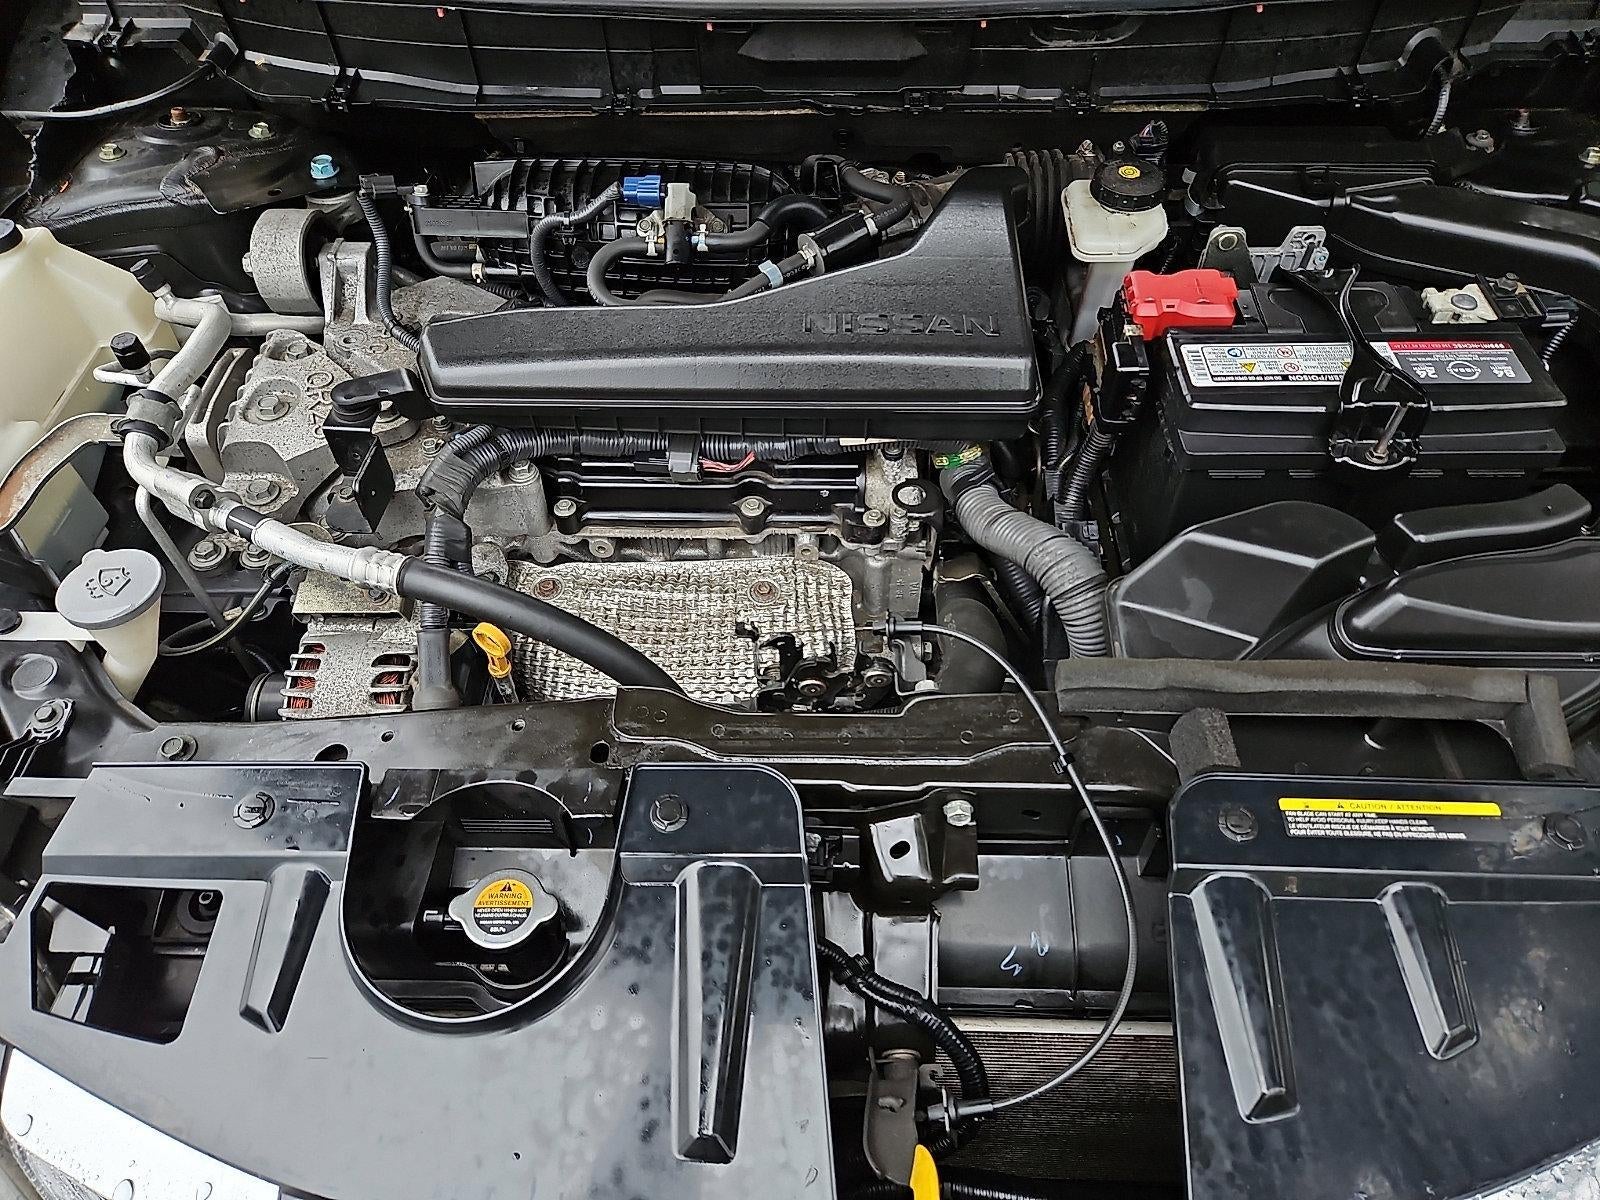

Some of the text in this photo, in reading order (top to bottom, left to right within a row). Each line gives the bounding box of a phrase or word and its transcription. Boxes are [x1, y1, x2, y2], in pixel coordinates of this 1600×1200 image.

[802, 313, 1000, 337] NISSAN
[1415, 369, 1439, 379] 24
[1493, 369, 1516, 378] 84
